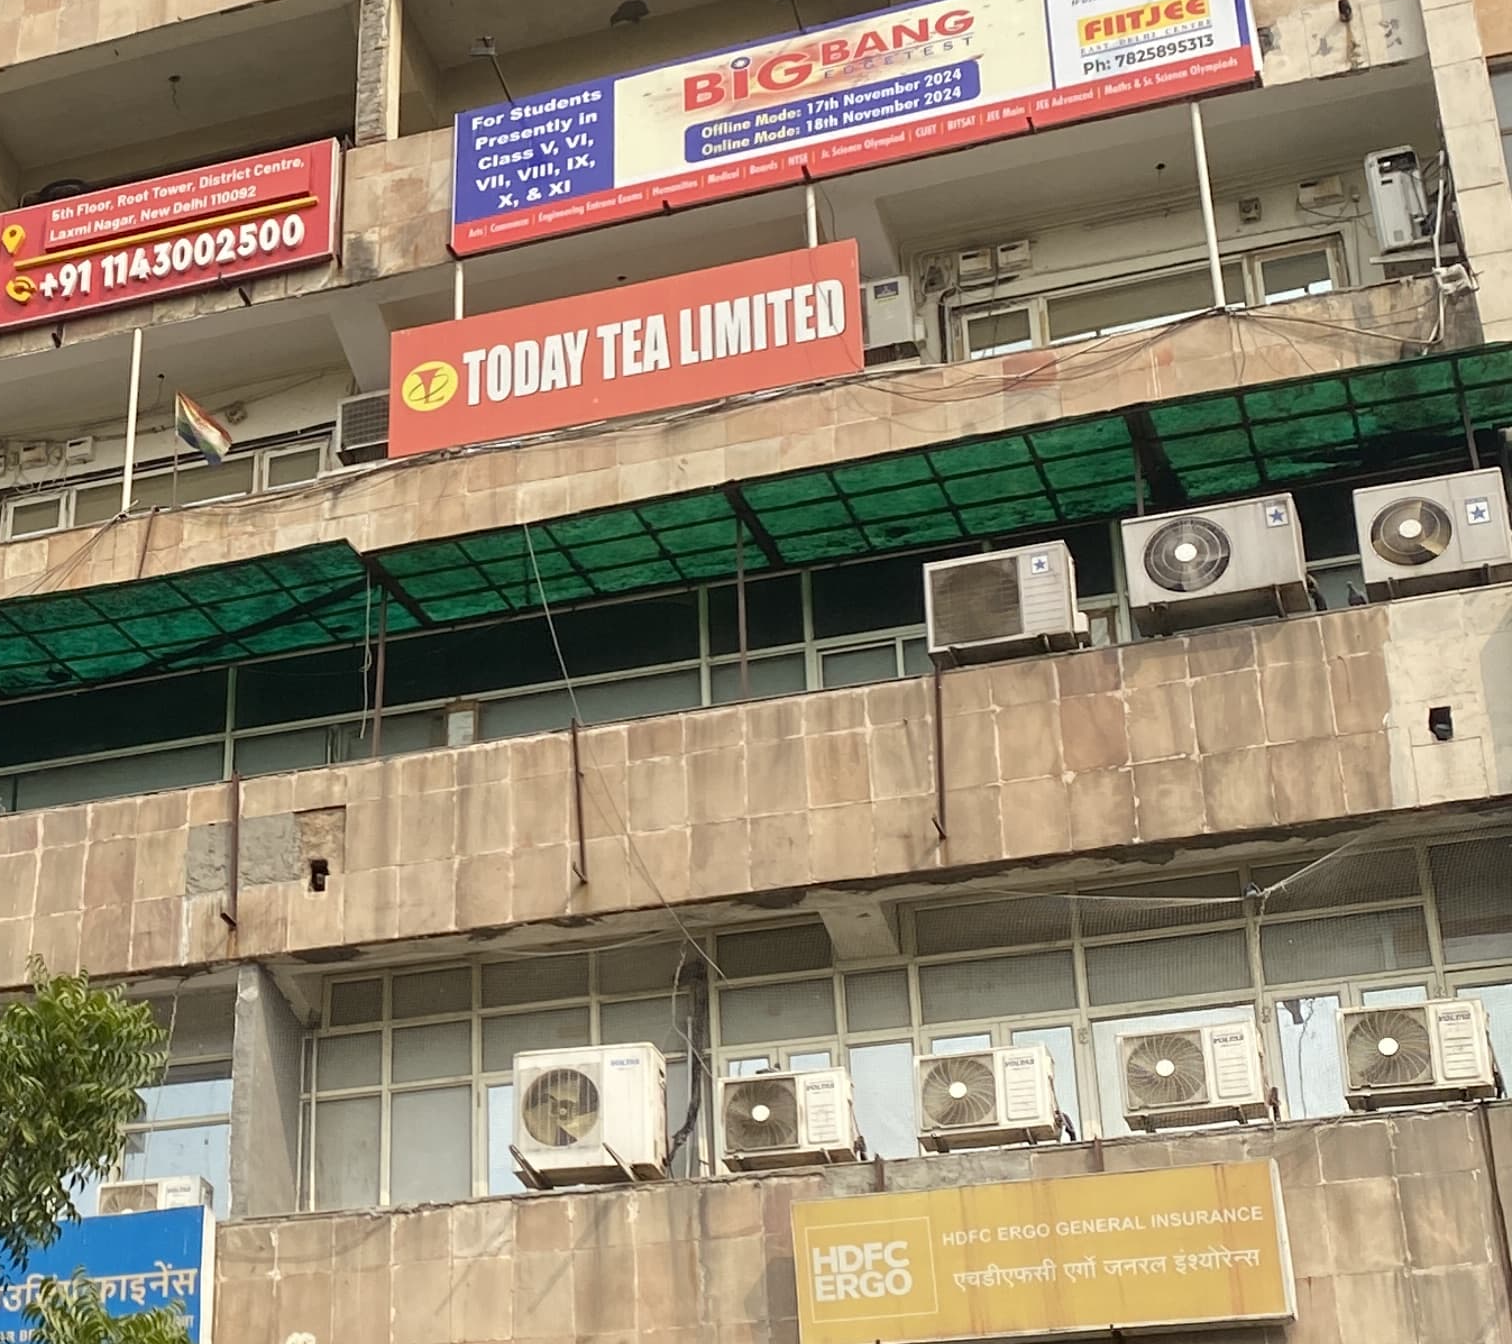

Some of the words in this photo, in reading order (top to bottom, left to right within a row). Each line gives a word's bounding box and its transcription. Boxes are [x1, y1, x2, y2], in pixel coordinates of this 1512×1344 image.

[1080, 42, 1109, 55] EAST
[1120, 30, 1156, 46] DELHI
[1165, 19, 1212, 36] CENTRE
[1083, 57, 1111, 75] Ph:
[1115, 33, 1214, 68] 7825895313
[472, 113, 504, 131] For
[510, 89, 602, 121] Students
[701, 119, 752, 140] Offline
[755, 108, 801, 128] Mode:
[807, 98, 839, 116] 17th
[843, 80, 920, 107] November
[924, 67, 962, 87] 2024
[701, 136, 750, 157] Online
[754, 126, 800, 145] Mode:
[805, 116, 838, 133] 18th
[842, 97, 919, 124] November
[924, 85, 962, 105] 2024
[475, 118, 573, 150] Presently
[579, 112, 597, 126] in
[478, 148, 534, 170] Class
[540, 141, 559, 156] V,
[565, 133, 594, 150] VI,
[51, 206, 74, 222] 5th
[77, 197, 114, 215] Floor,
[117, 190, 148, 208] Root
[152, 181, 196, 200] Tower,
[199, 168, 251, 189] District
[254, 157, 305, 177] Centre,
[475, 173, 511, 192] VII,
[517, 162, 560, 182] VIII,
[567, 154, 595, 171] IX,
[498, 193, 519, 208] X,
[526, 187, 542, 201] &
[548, 179, 571, 197] XI
[49, 224, 91, 242] Laxmi
[94, 215, 137, 234] Nagar,
[141, 206, 171, 221] New
[173, 199, 207, 215] Delhi
[211, 186, 257, 204] 110092
[39, 259, 91, 298] +91
[100, 213, 306, 286] 1143002500
[463, 328, 589, 407] TODAY
[596, 315, 671, 381] TEA
[680, 279, 845, 367] LIMITED
[942, 1228, 992, 1248] HDFC
[997, 1223, 1050, 1241] ERGO
[1056, 1213, 1145, 1237] GENERAL
[1151, 1206, 1263, 1230] INSURANCE
[812, 1240, 910, 1275] HDFC
[953, 1257, 1056, 1293] एचडीएफसी
[1104, 1256, 1167, 1279] जनरल
[815, 1268, 912, 1302] ERGO
